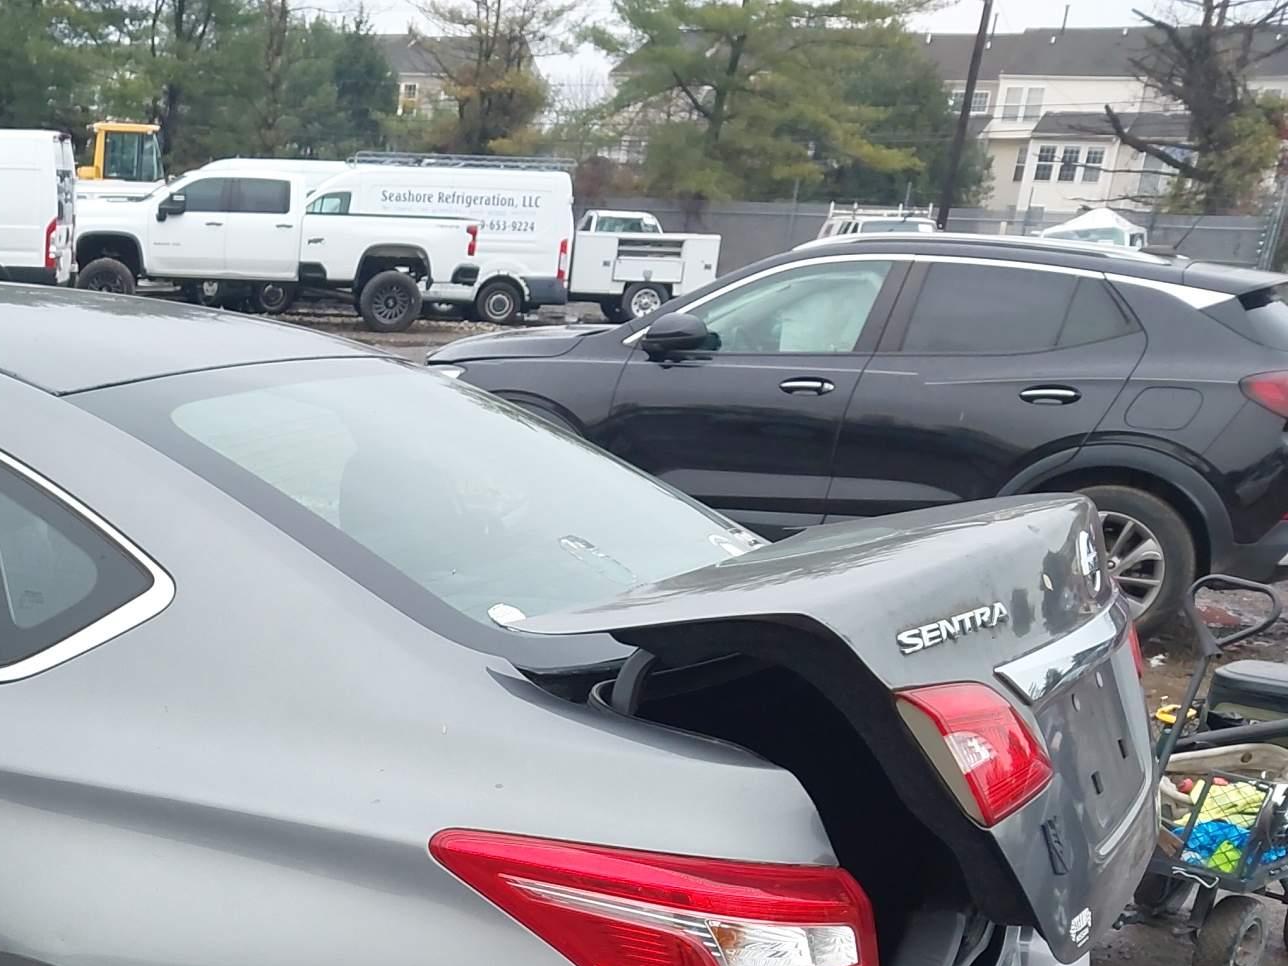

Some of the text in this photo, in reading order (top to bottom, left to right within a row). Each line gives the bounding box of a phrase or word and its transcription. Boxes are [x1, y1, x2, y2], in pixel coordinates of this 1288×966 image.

[381, 189, 541, 209] Seashore Refrigeration, LLC
[896, 601, 1009, 654] SENTRA
